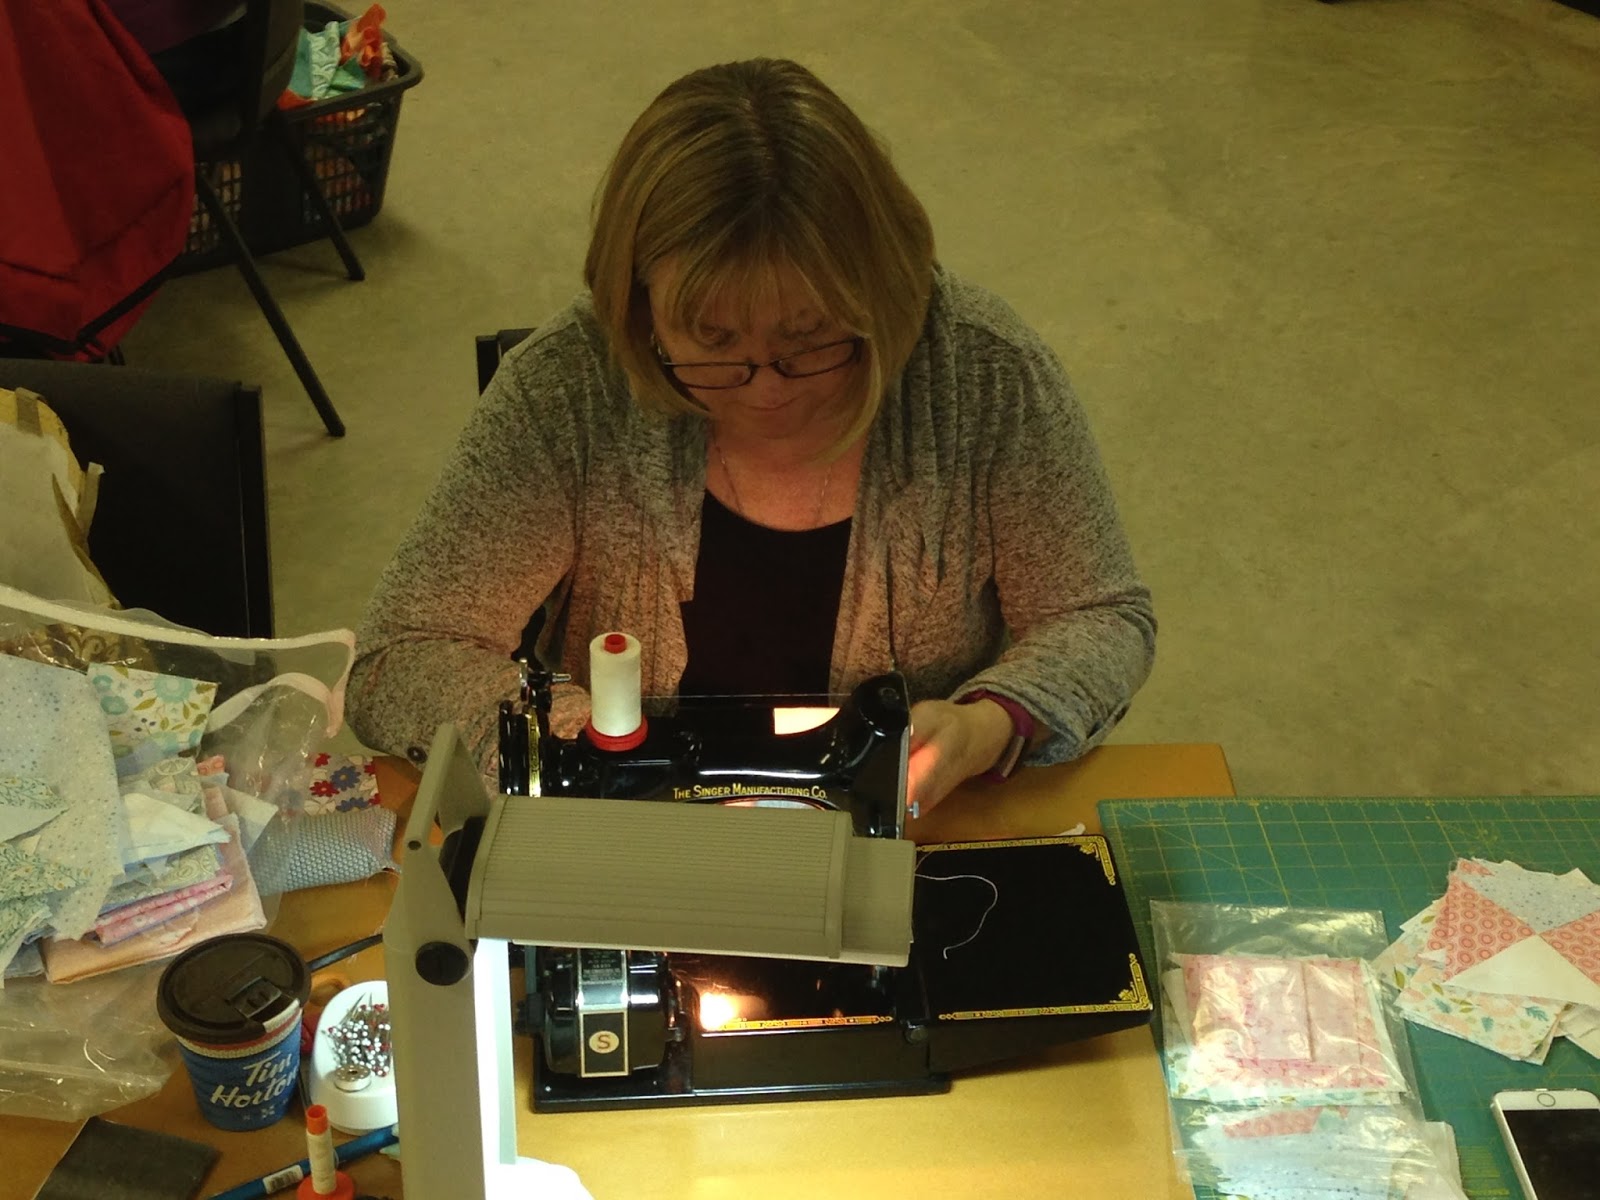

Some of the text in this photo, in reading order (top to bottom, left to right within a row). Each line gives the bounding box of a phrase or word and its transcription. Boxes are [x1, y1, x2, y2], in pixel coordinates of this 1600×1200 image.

[673, 787, 691, 799] THE
[693, 784, 731, 797] SINGER
[732, 782, 810, 797] MANUFACTURING
[597, 1034, 611, 1050] S
[242, 1051, 292, 1087] Tim
